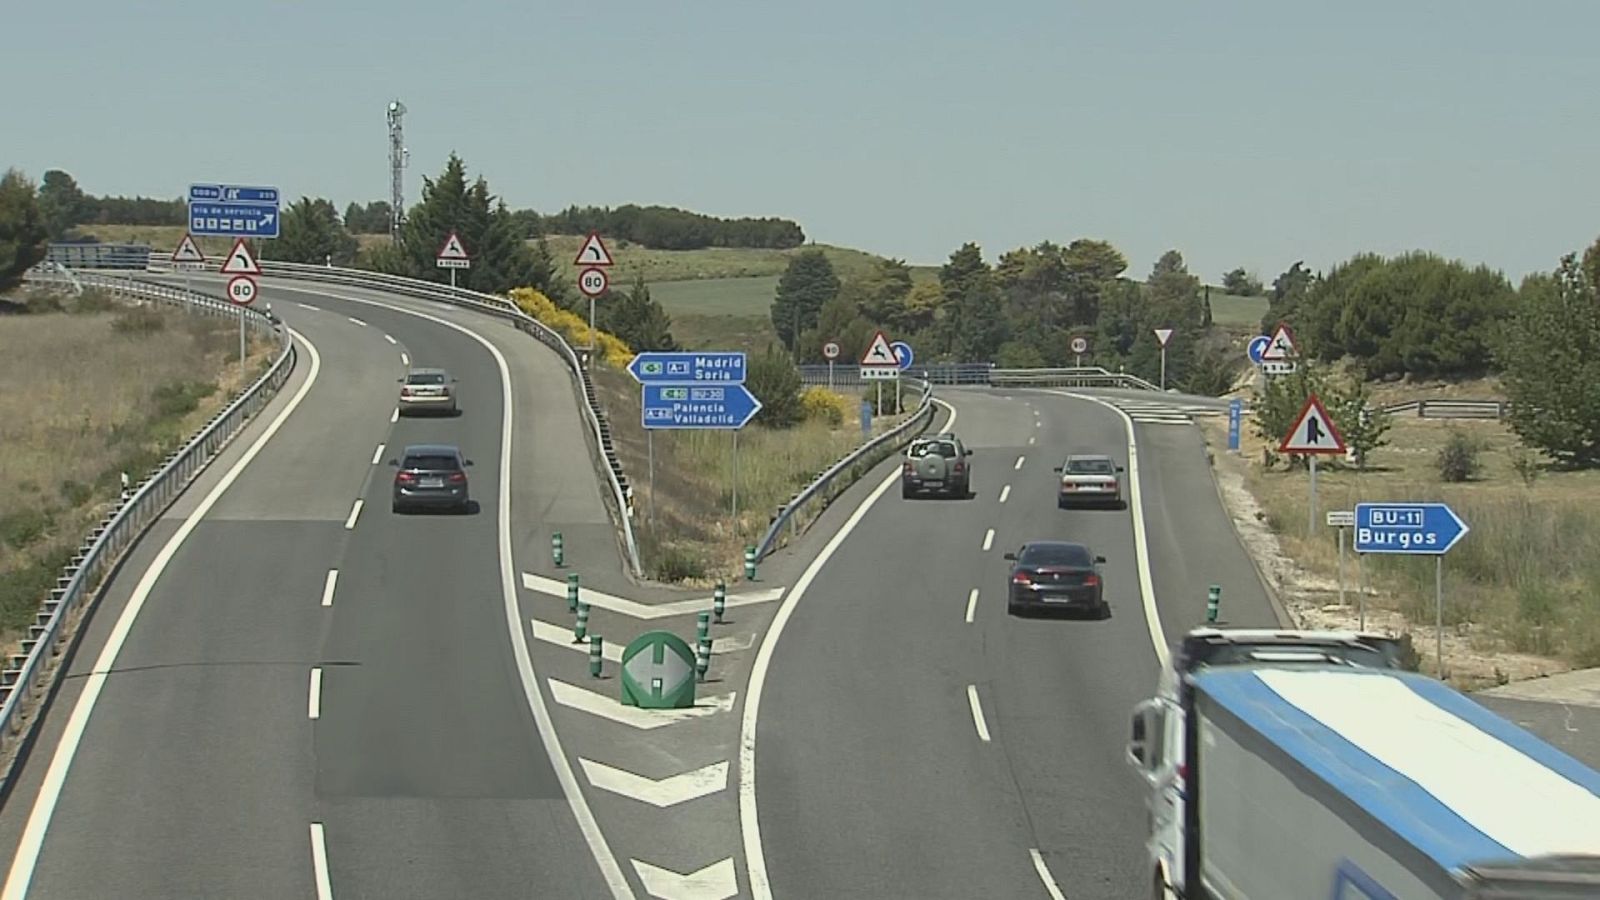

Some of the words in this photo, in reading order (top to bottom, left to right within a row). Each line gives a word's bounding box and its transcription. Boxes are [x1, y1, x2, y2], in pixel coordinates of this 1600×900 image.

[585, 277, 602, 287] 80
[234, 285, 251, 296] 80
[695, 357, 741, 368] Madrid
[695, 369, 731, 379] Soria
[673, 403, 725, 412] Palencia
[674, 414, 734, 423] Valladolid
[1373, 511, 1420, 524] BU-11
[1359, 528, 1436, 549] Burgos
